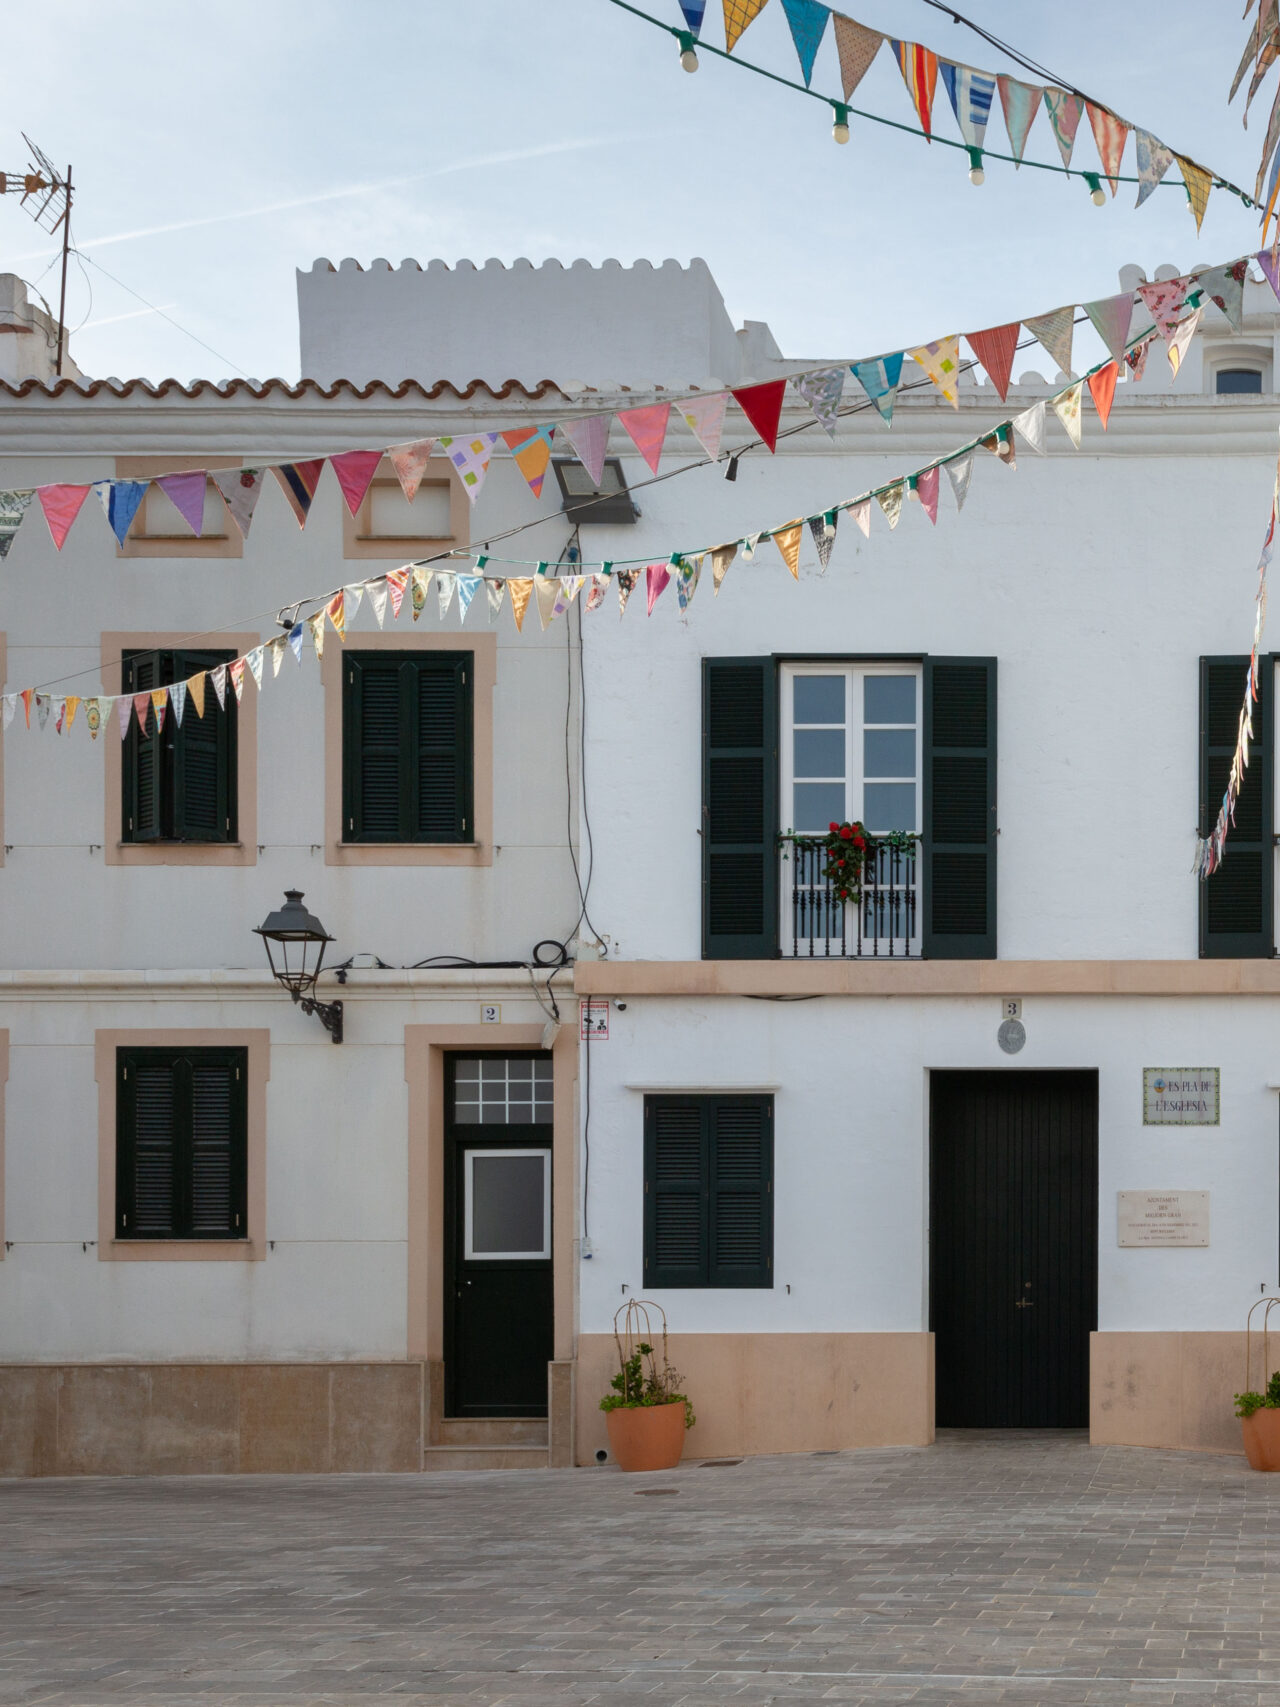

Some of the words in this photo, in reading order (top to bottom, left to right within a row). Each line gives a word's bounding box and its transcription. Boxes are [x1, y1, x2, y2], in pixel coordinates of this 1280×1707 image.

[486, 1007, 496, 1021] 2
[1008, 1002, 1017, 1016] 3
[1168, 1080, 1180, 1092] ES
[1182, 1080, 1198, 1092] PLA
[1200, 1080, 1212, 1092] DE
